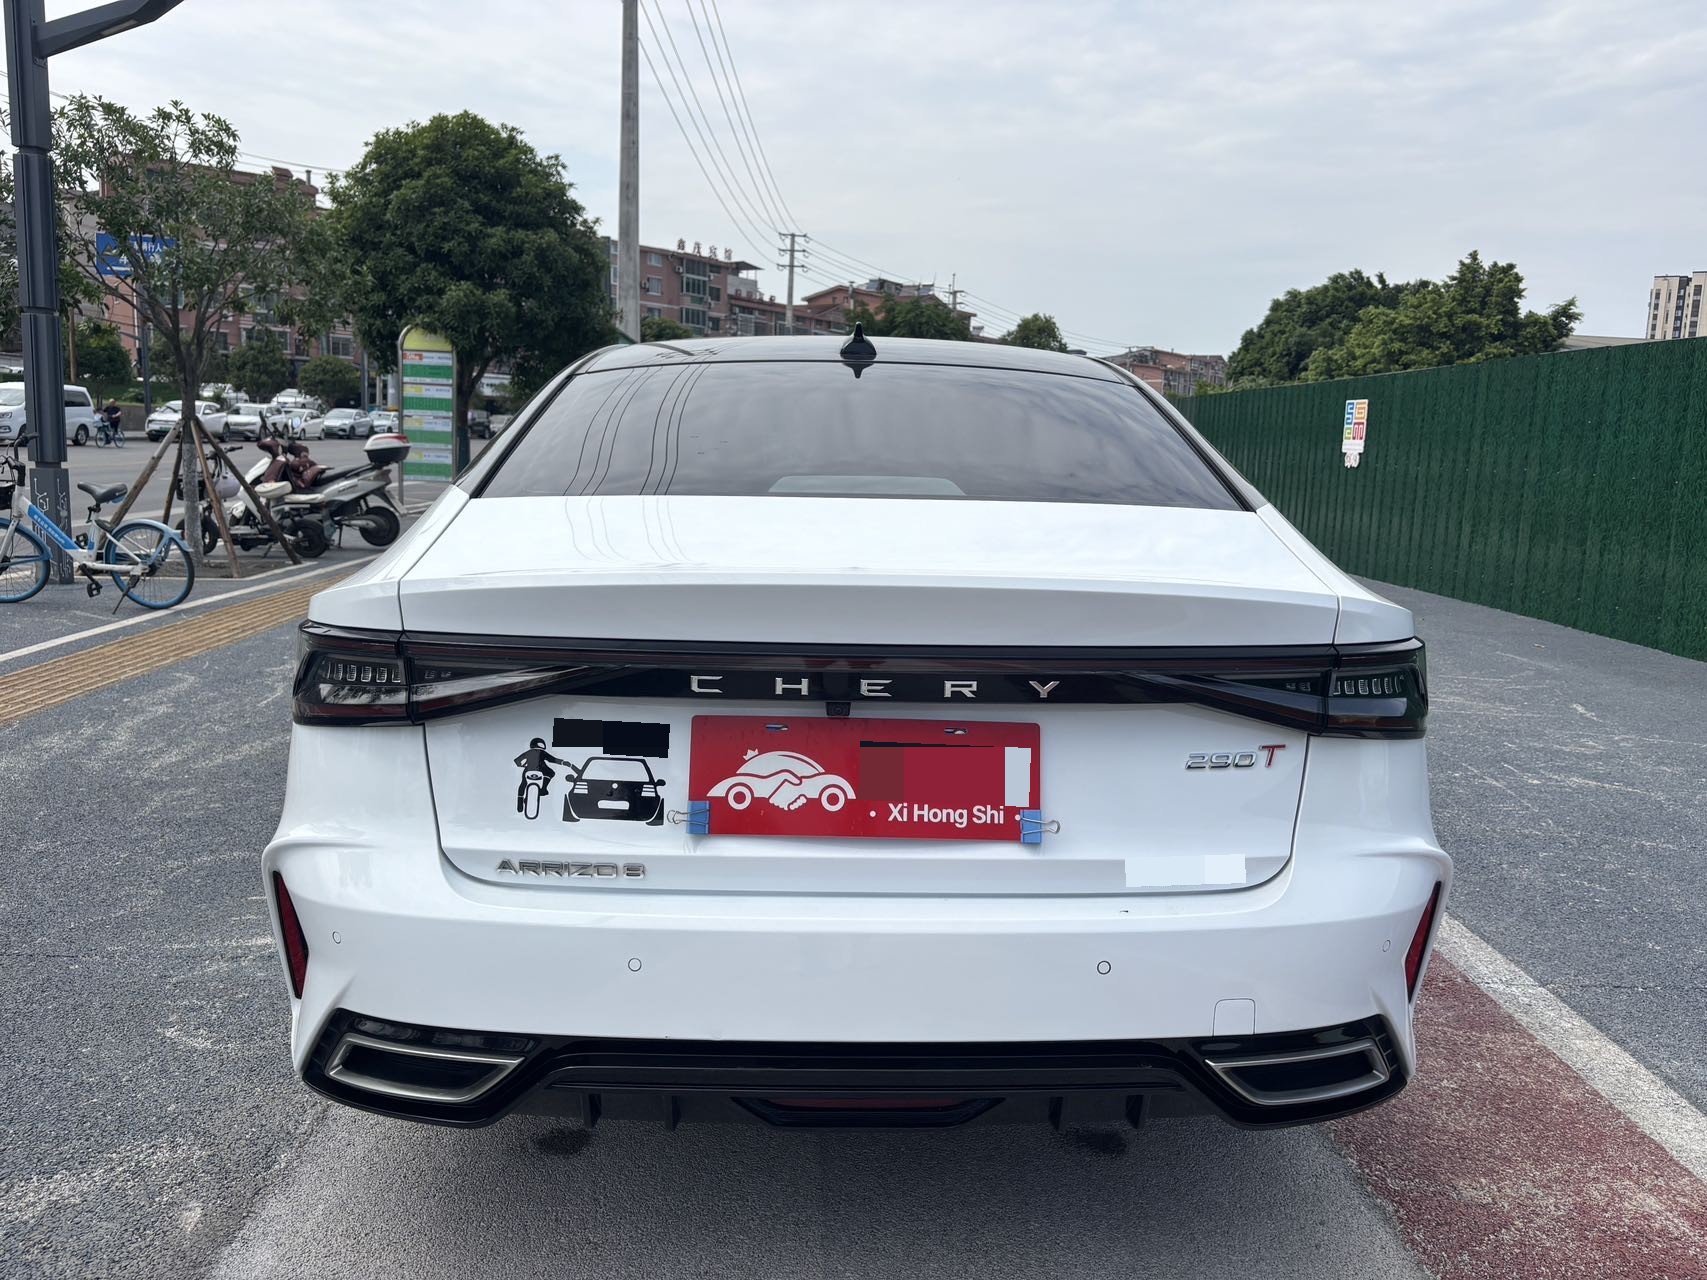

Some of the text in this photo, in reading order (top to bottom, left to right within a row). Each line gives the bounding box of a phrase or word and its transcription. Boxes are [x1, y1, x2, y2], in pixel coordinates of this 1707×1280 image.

[690, 675, 1061, 699] CHERY
[1185, 744, 1286, 770] 290T
[888, 803, 1004, 828] Xi Hong Shi
[497, 859, 646, 879] ARRIZO 8
